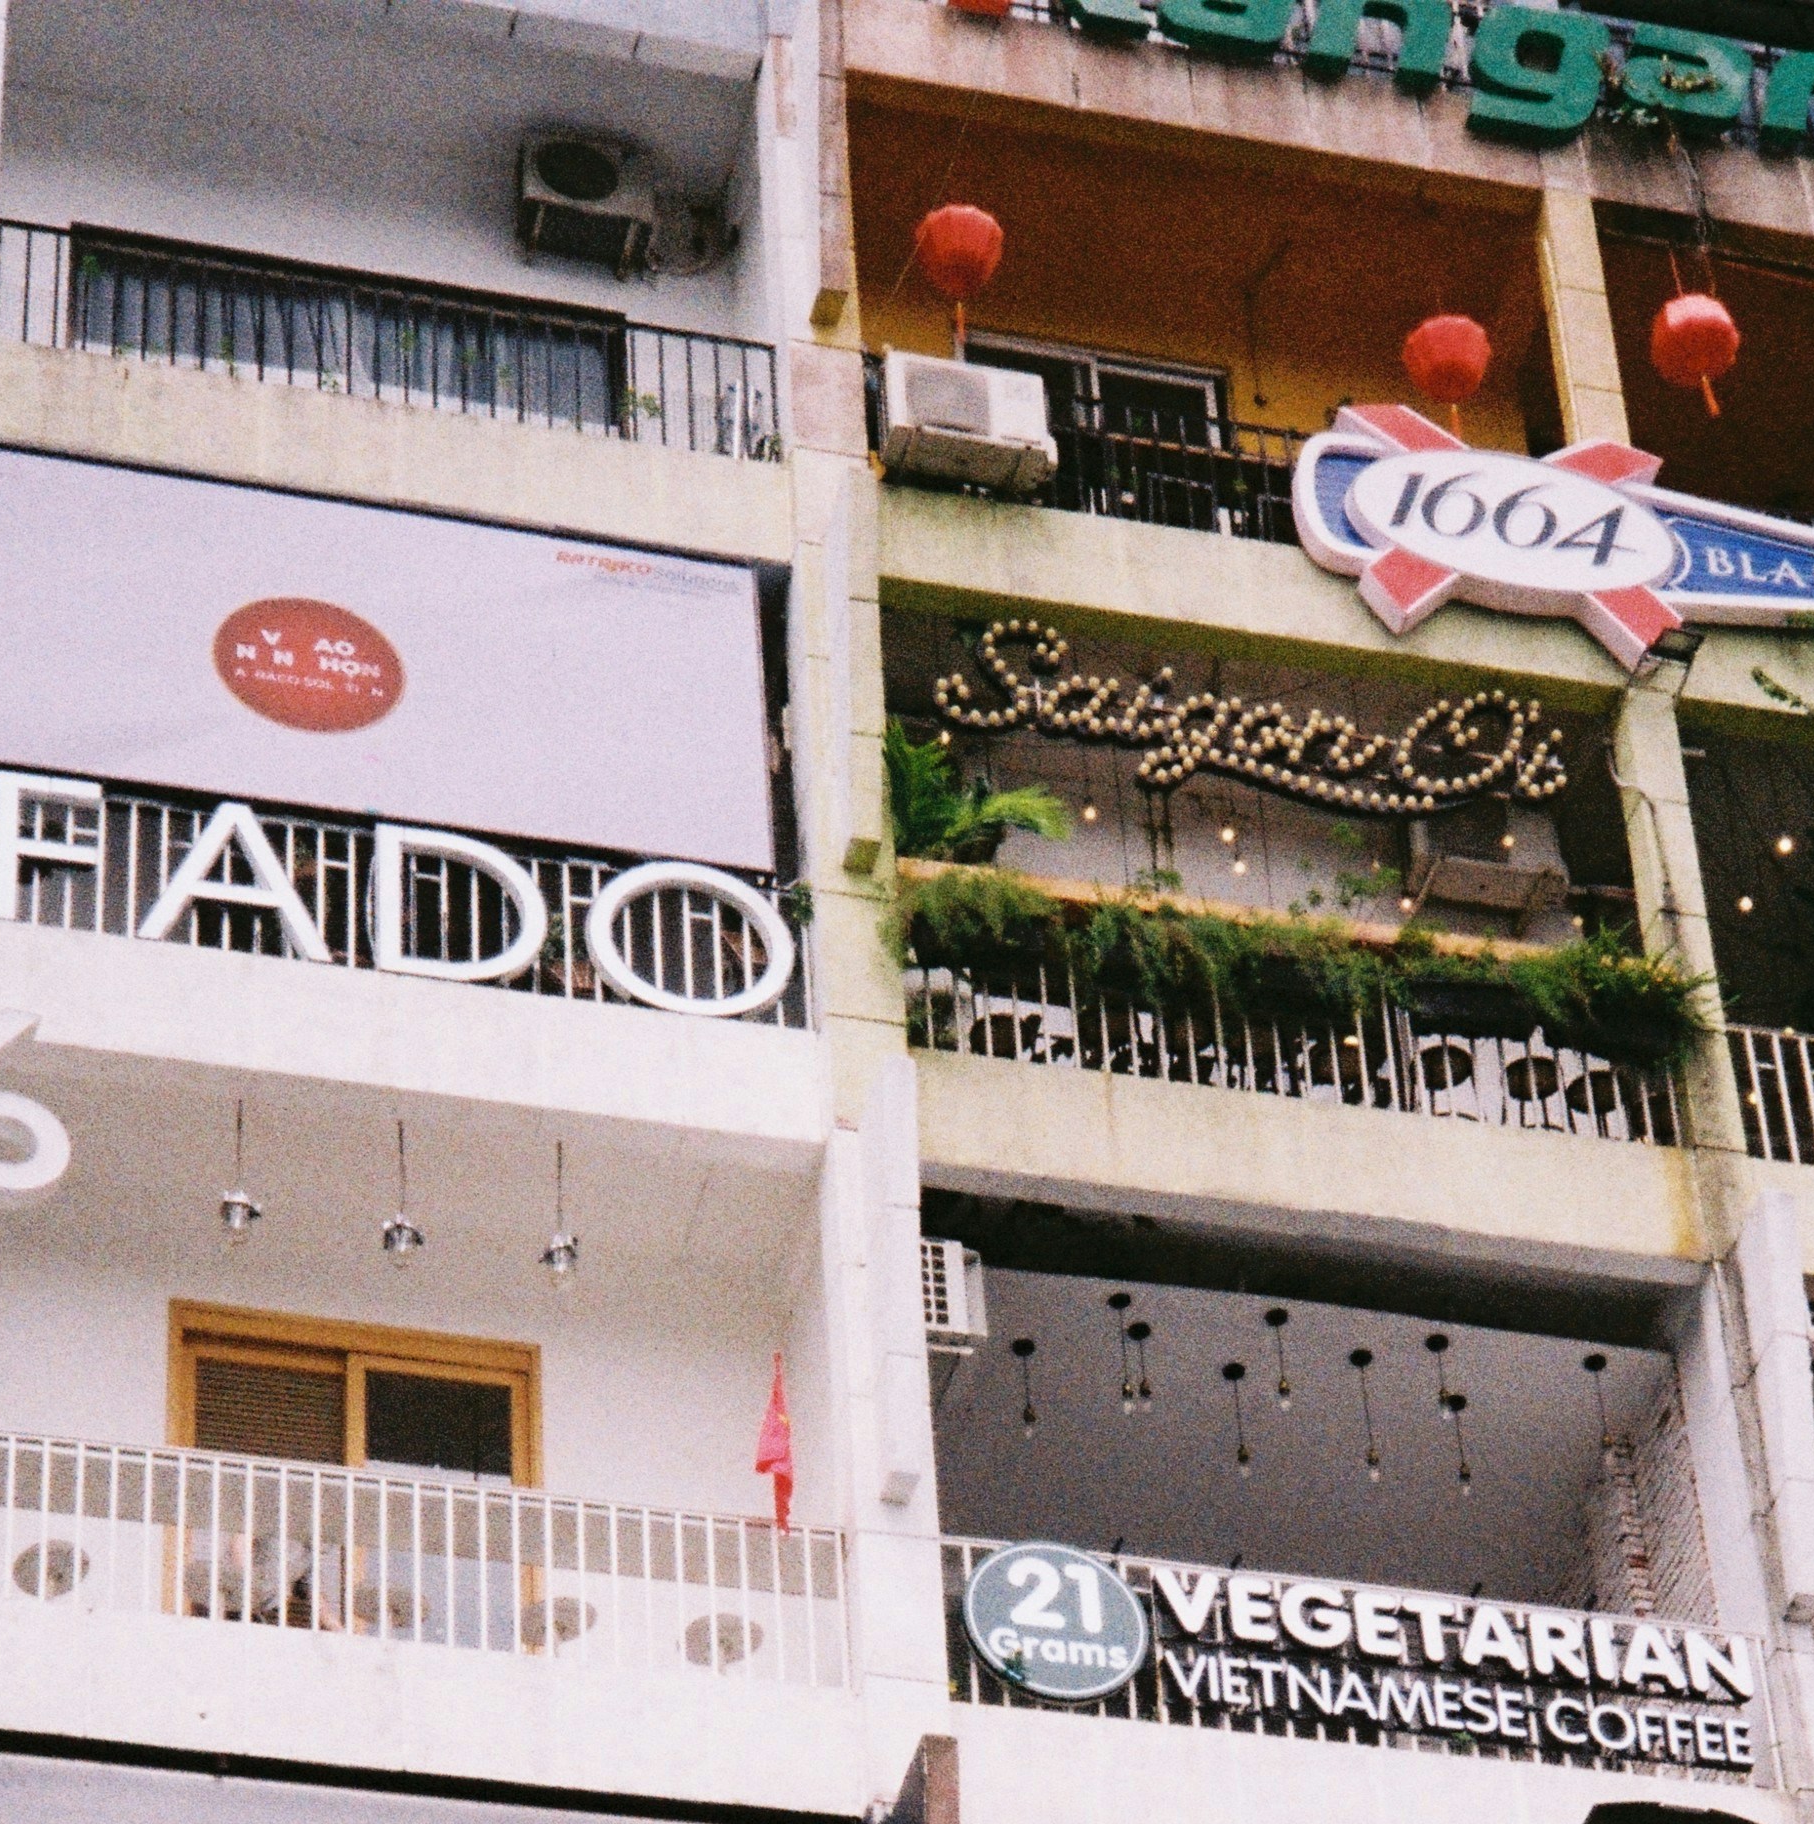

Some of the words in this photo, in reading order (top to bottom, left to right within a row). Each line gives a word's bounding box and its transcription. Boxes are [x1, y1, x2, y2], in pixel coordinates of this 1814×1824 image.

[1388, 470, 1631, 568] 1664
[1005, 1555, 1104, 1634] 21
[1151, 1566, 1756, 1703] VEGETARIAN
[987, 1630, 1129, 1672] Grams
[1162, 1649, 1526, 1740] VIETNAMESE
[1544, 1694, 1753, 1770] COFFEE
